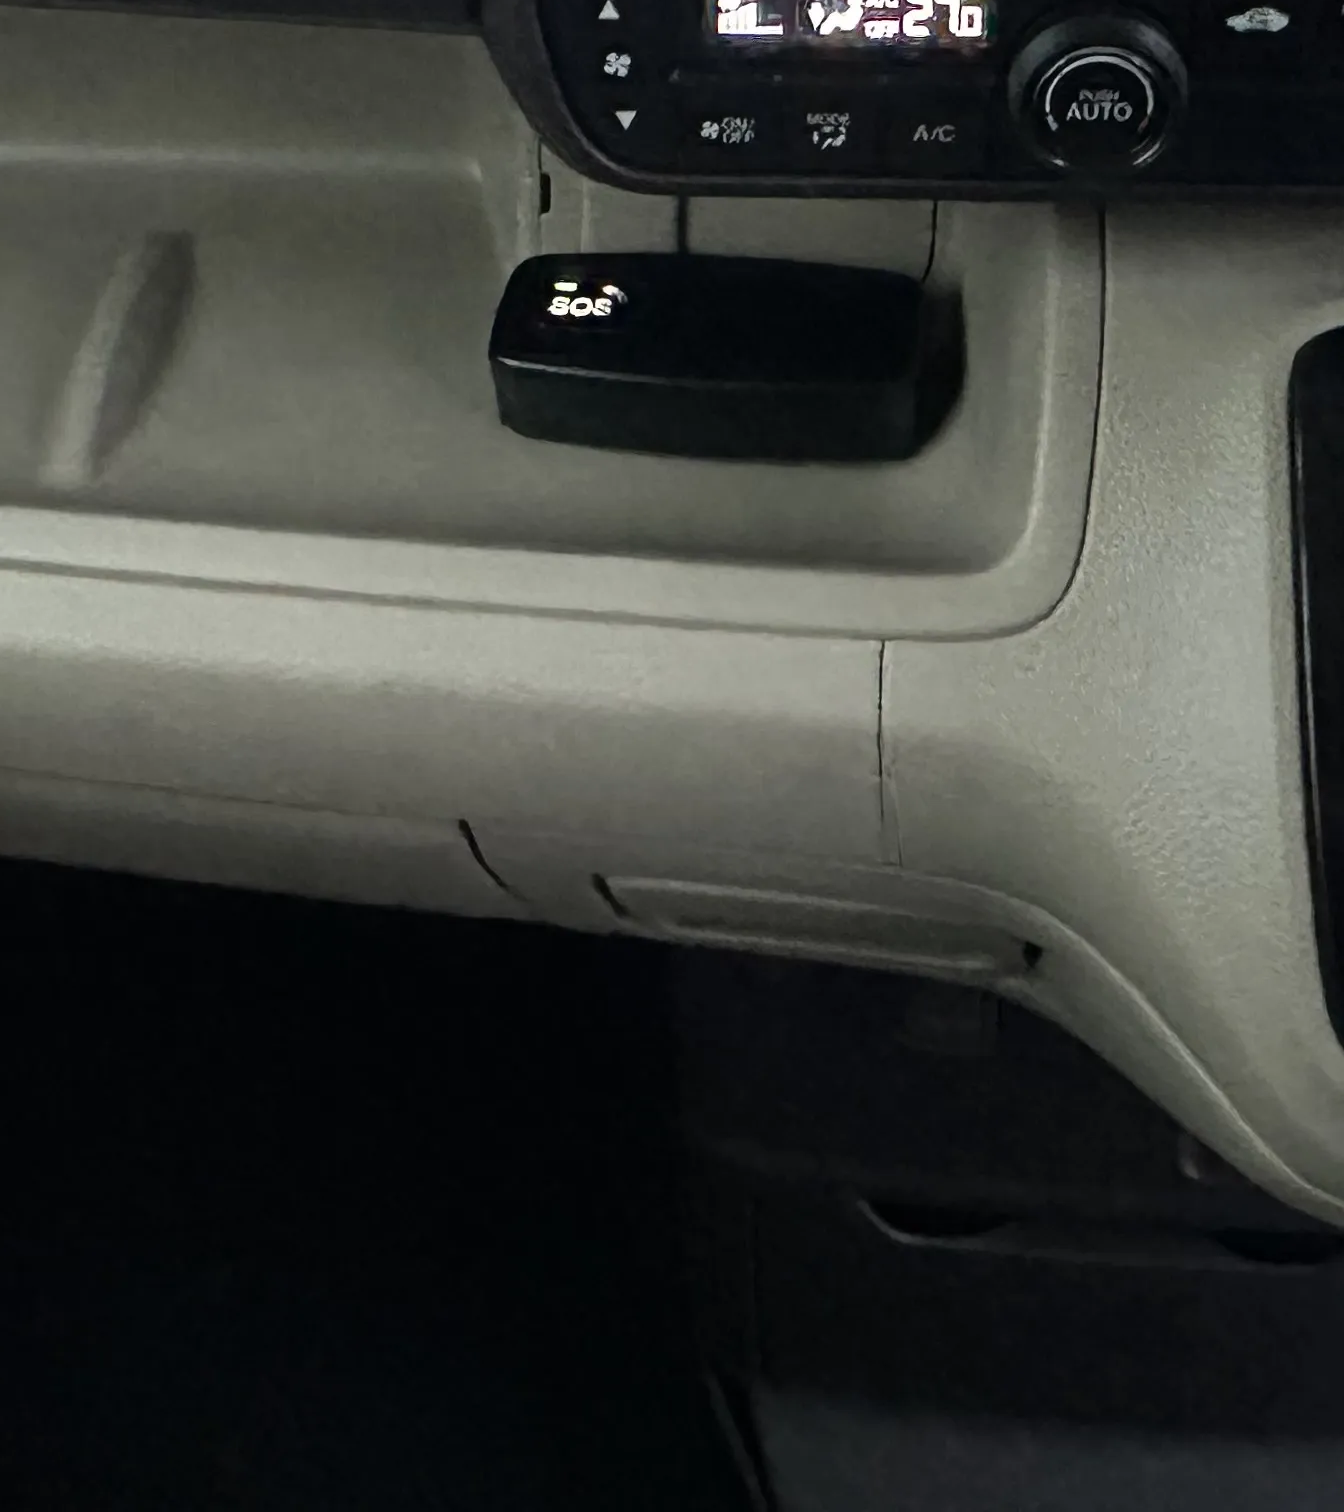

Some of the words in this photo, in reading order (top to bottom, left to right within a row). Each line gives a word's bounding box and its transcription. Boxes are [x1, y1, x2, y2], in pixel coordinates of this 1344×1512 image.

[1066, 101, 1133, 123] AUTO
[912, 123, 956, 142] A/C
[547, 295, 613, 317] SOS
